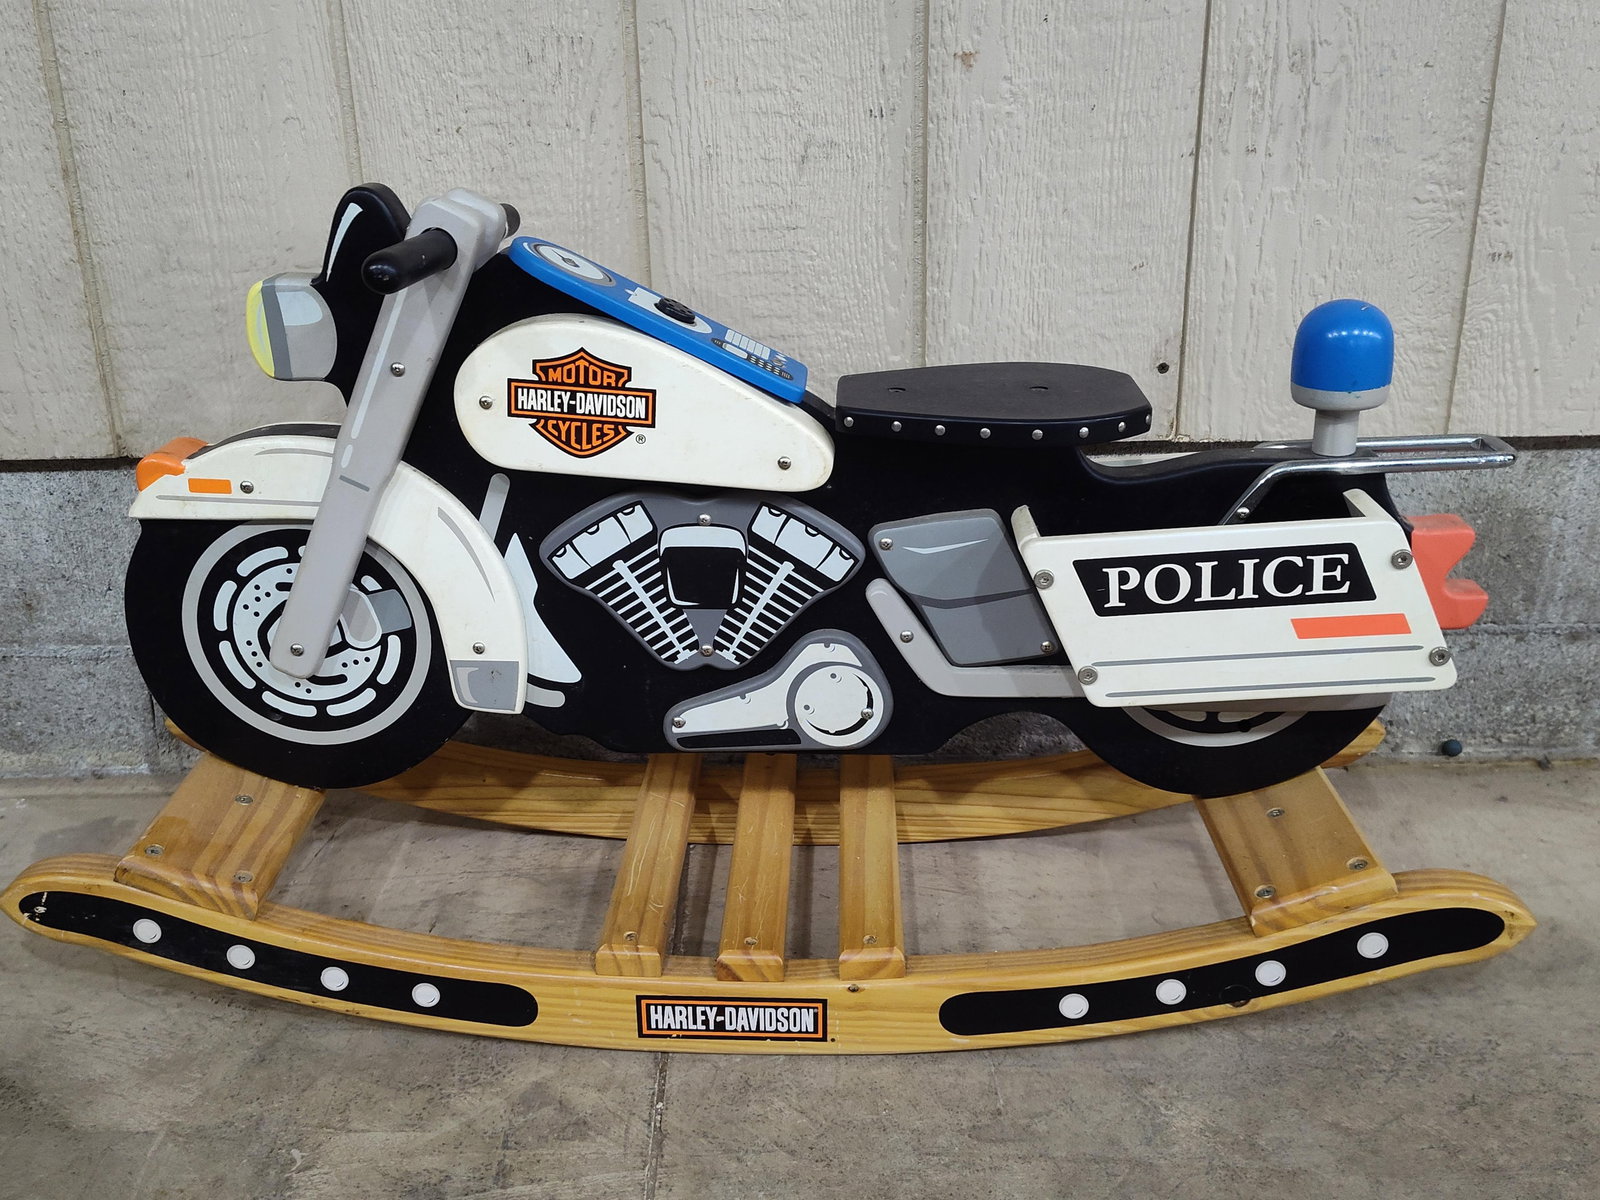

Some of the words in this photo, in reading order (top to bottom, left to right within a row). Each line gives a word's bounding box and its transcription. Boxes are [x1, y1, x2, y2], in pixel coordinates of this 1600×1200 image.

[548, 359, 617, 387] MOTOR
[517, 388, 646, 419] HARLEY-DAVIDSON
[547, 419, 615, 450] CYCLES
[1102, 553, 1350, 608] POLICE
[650, 1005, 815, 1032] HARLEY-DAVIDSON
